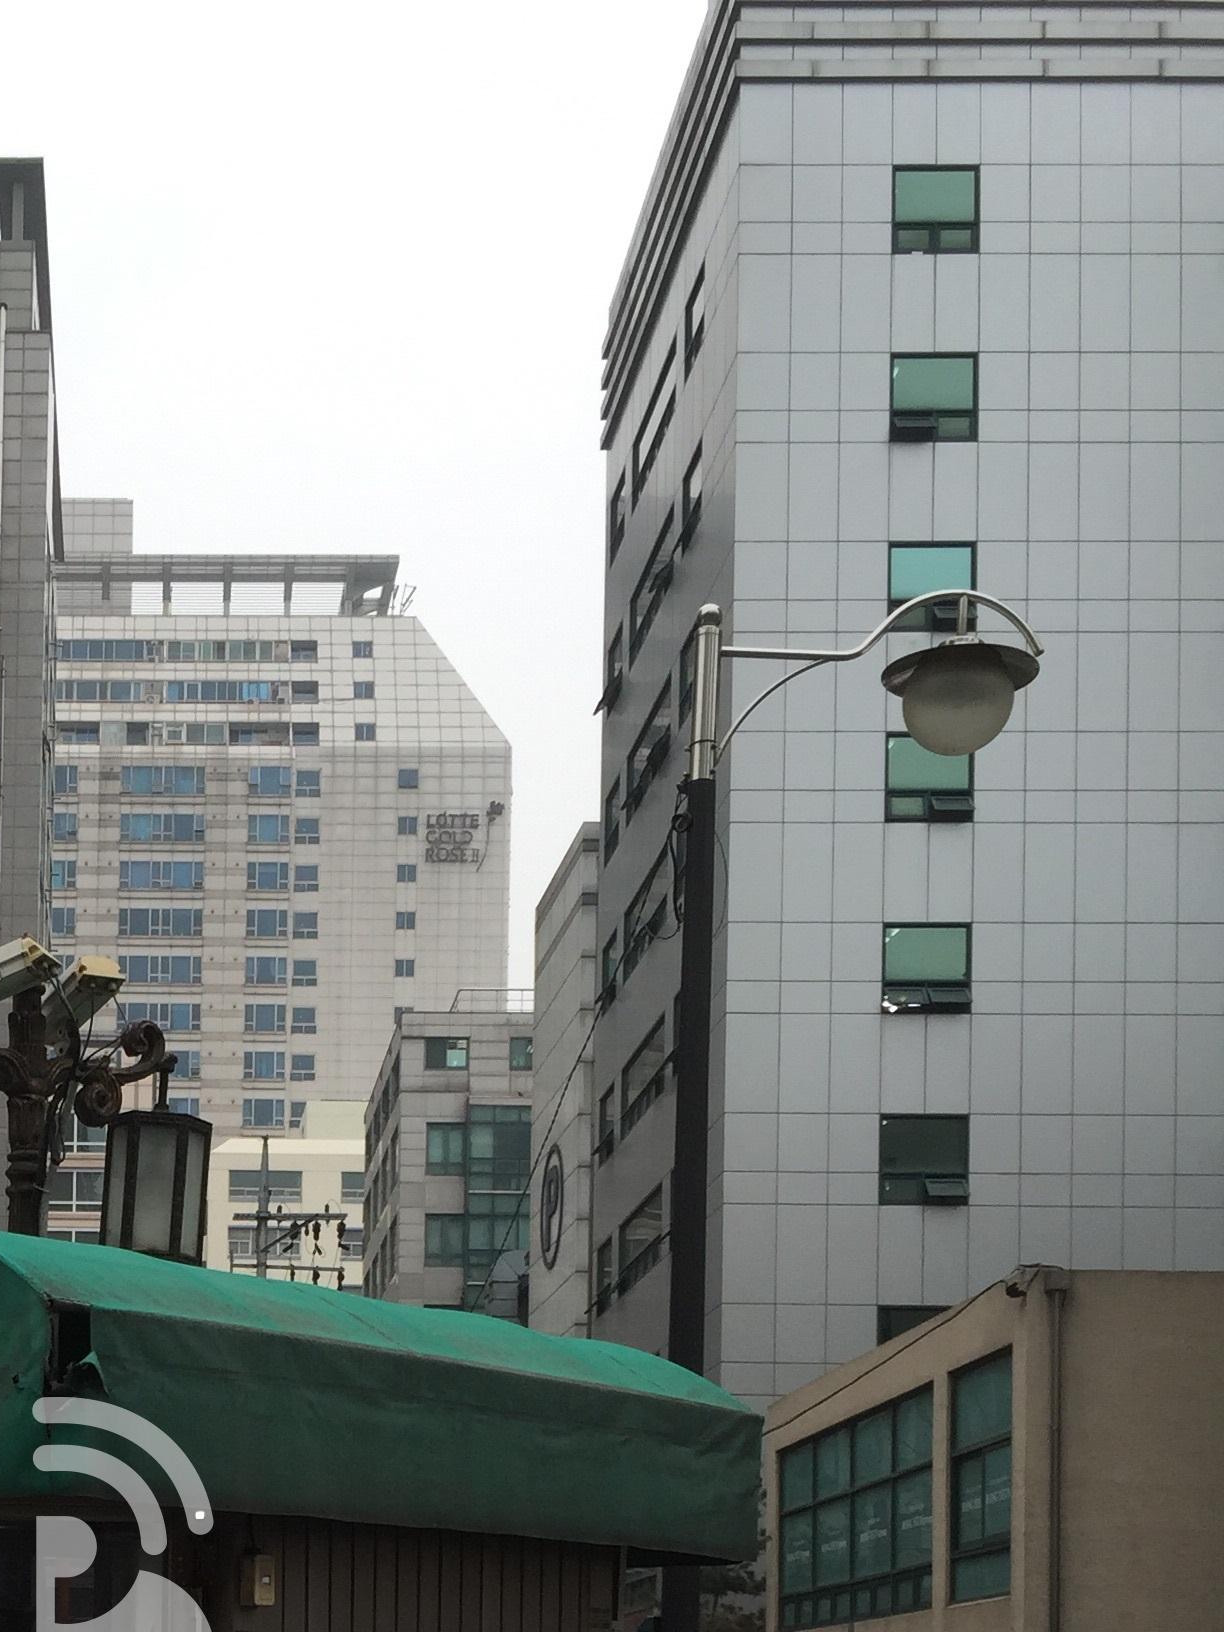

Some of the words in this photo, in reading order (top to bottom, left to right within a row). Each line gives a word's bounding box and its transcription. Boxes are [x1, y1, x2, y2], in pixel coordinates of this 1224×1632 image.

[426, 812, 480, 829] LOTTE
[426, 830, 473, 845] GOLD
[425, 847, 468, 863] ROSE
